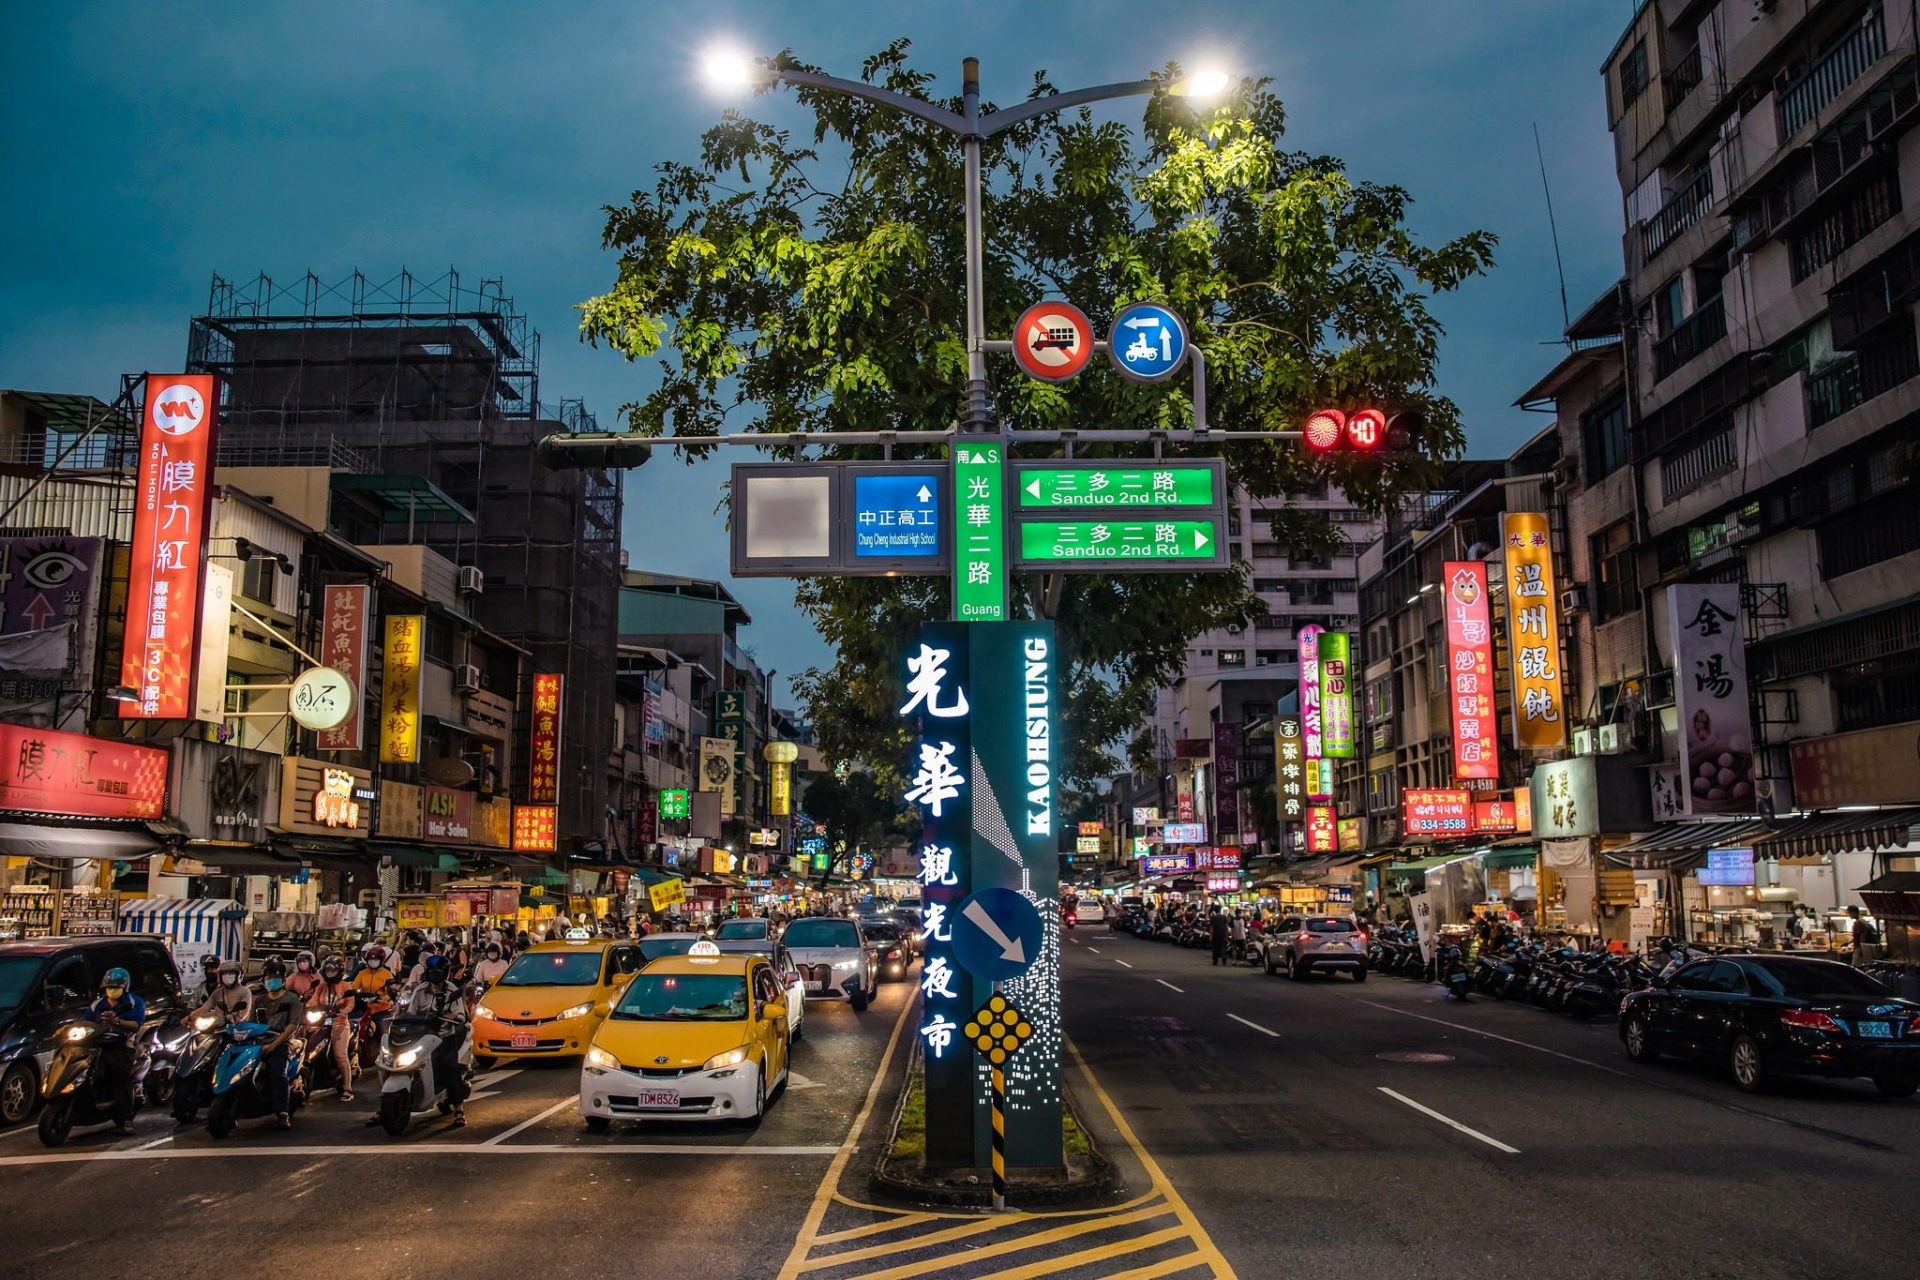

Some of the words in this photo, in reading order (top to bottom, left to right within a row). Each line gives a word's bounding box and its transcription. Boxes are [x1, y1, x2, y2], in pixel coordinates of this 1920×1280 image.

[1349, 418, 1375, 443] 40
[151, 443, 159, 459] MO
[957, 451, 969, 463] 南
[988, 450, 1000, 463] S.
[150, 464, 157, 474] LI
[1056, 472, 1176, 492] 三多二路
[147, 479, 156, 510] HONG
[1051, 492, 1114, 504] Sanduo
[1119, 492, 1149, 503] 2nd
[1154, 492, 1182, 503] Rd.
[156, 460, 196, 573] 膜力紅
[859, 510, 935, 526] 中正高工
[859, 533, 874, 548] Chung
[874, 533, 888, 548] Cheng
[889, 532, 908, 545] Industrial
[909, 532, 919, 548] High
[920, 532, 935, 545] School
[967, 476, 992, 584] 光華二路
[1057, 524, 1177, 544] 三多二路
[1053, 545, 1115, 557] Sanduo
[1121, 544, 1150, 556] 2nd
[1157, 544, 1184, 555] Rd.
[150, 581, 169, 638] 專業包膜
[962, 604, 1000, 616] Guang
[1514, 564, 1558, 722] 溫州餛飩
[1684, 598, 1737, 699] 金湯
[143, 651, 161, 715] 3C配件
[1324, 659, 1346, 695] 田心
[1456, 650, 1480, 761] 炒飯專賣店
[1024, 638, 1050, 836] KAOHSIUNG
[430, 792, 456, 816] ASH
[428, 821, 446, 835] Hair
[448, 822, 468, 837] Salon
[1421, 819, 1466, 830] 334-9588
